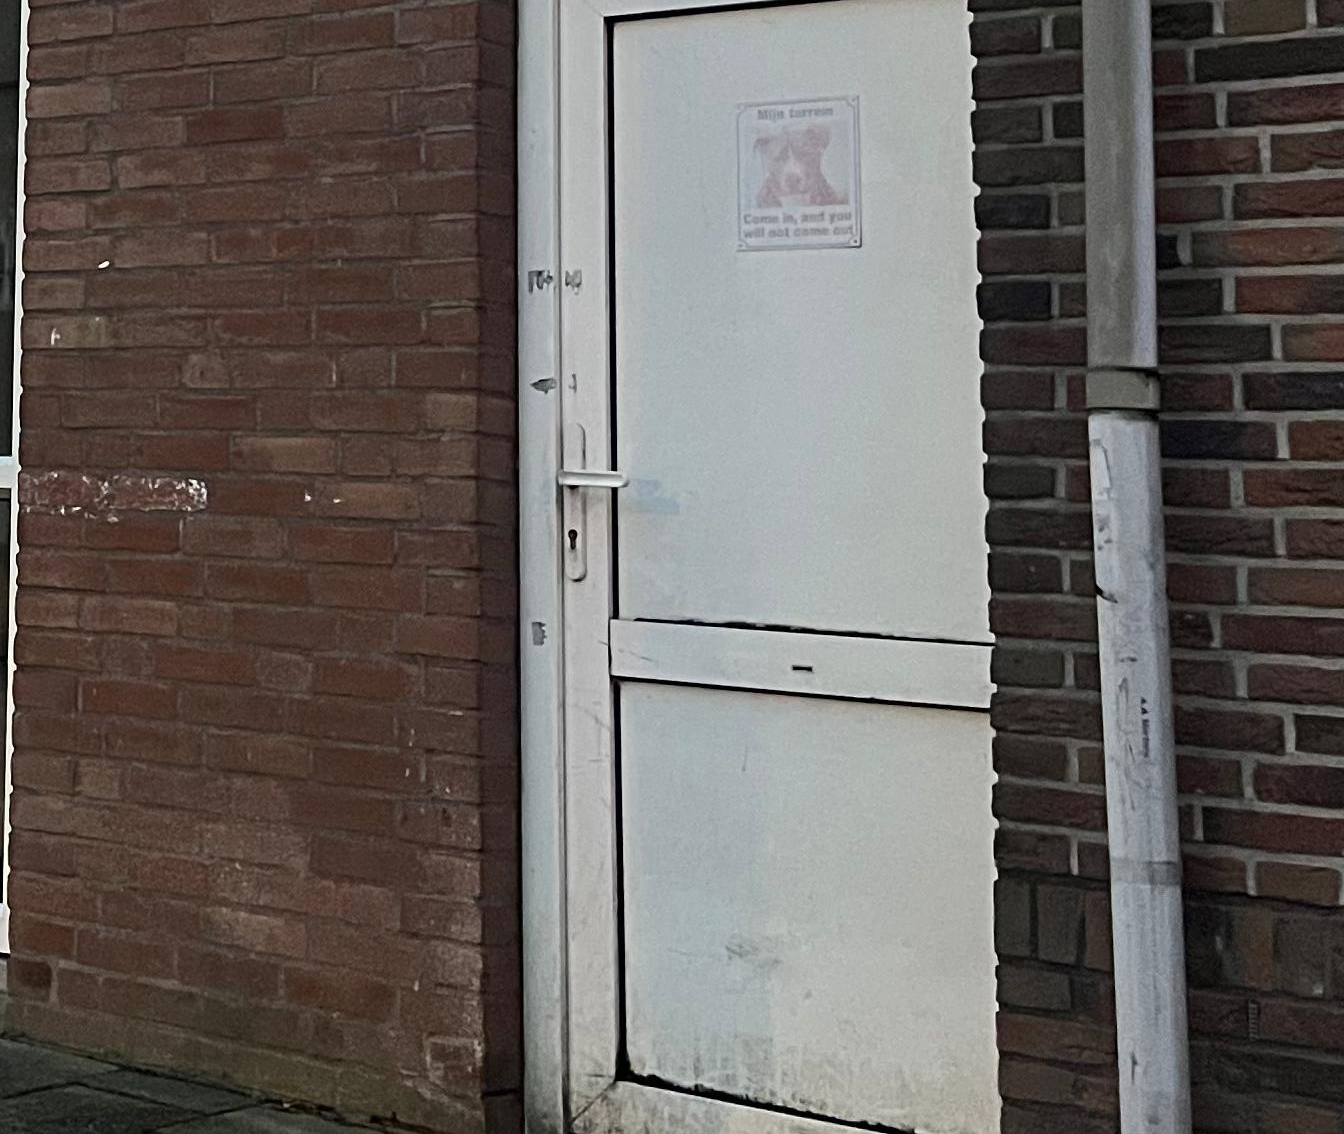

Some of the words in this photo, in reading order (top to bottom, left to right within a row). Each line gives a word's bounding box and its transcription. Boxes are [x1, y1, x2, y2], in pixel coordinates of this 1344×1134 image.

[757, 108, 784, 123] Mijn
[743, 213, 778, 225] Come
[782, 212, 798, 226] in,
[801, 211, 825, 223] and
[828, 212, 852, 225] you
[743, 228, 765, 239] will
[768, 227, 790, 238] not
[793, 226, 830, 237] come
[832, 224, 854, 236] out
